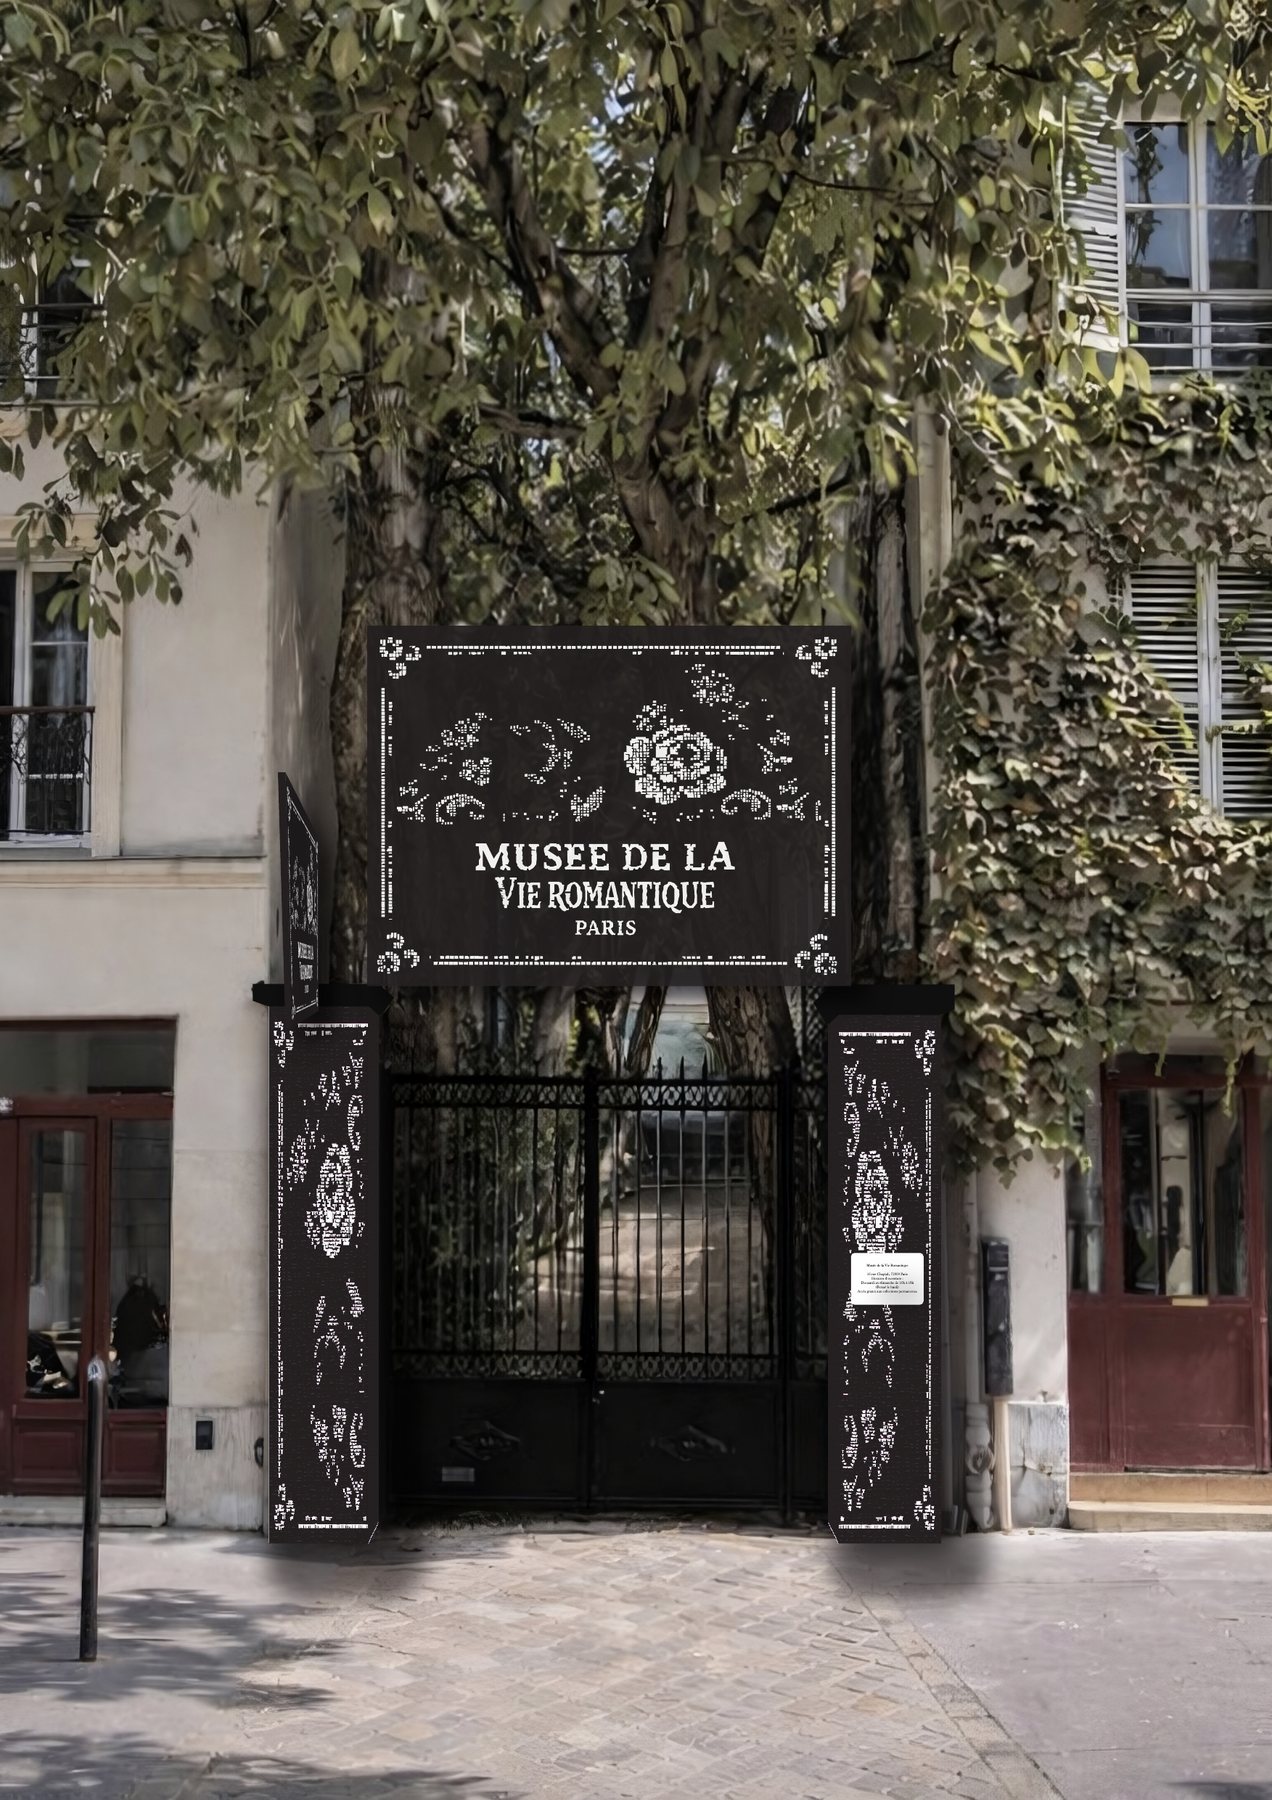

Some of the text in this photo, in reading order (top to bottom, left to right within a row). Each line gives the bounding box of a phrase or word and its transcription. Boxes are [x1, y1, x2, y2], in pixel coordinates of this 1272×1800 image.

[475, 842, 735, 871] MUSEE DE LA
[495, 877, 714, 913] VIE ROMANTIQUE
[575, 920, 636, 935] PARIS
